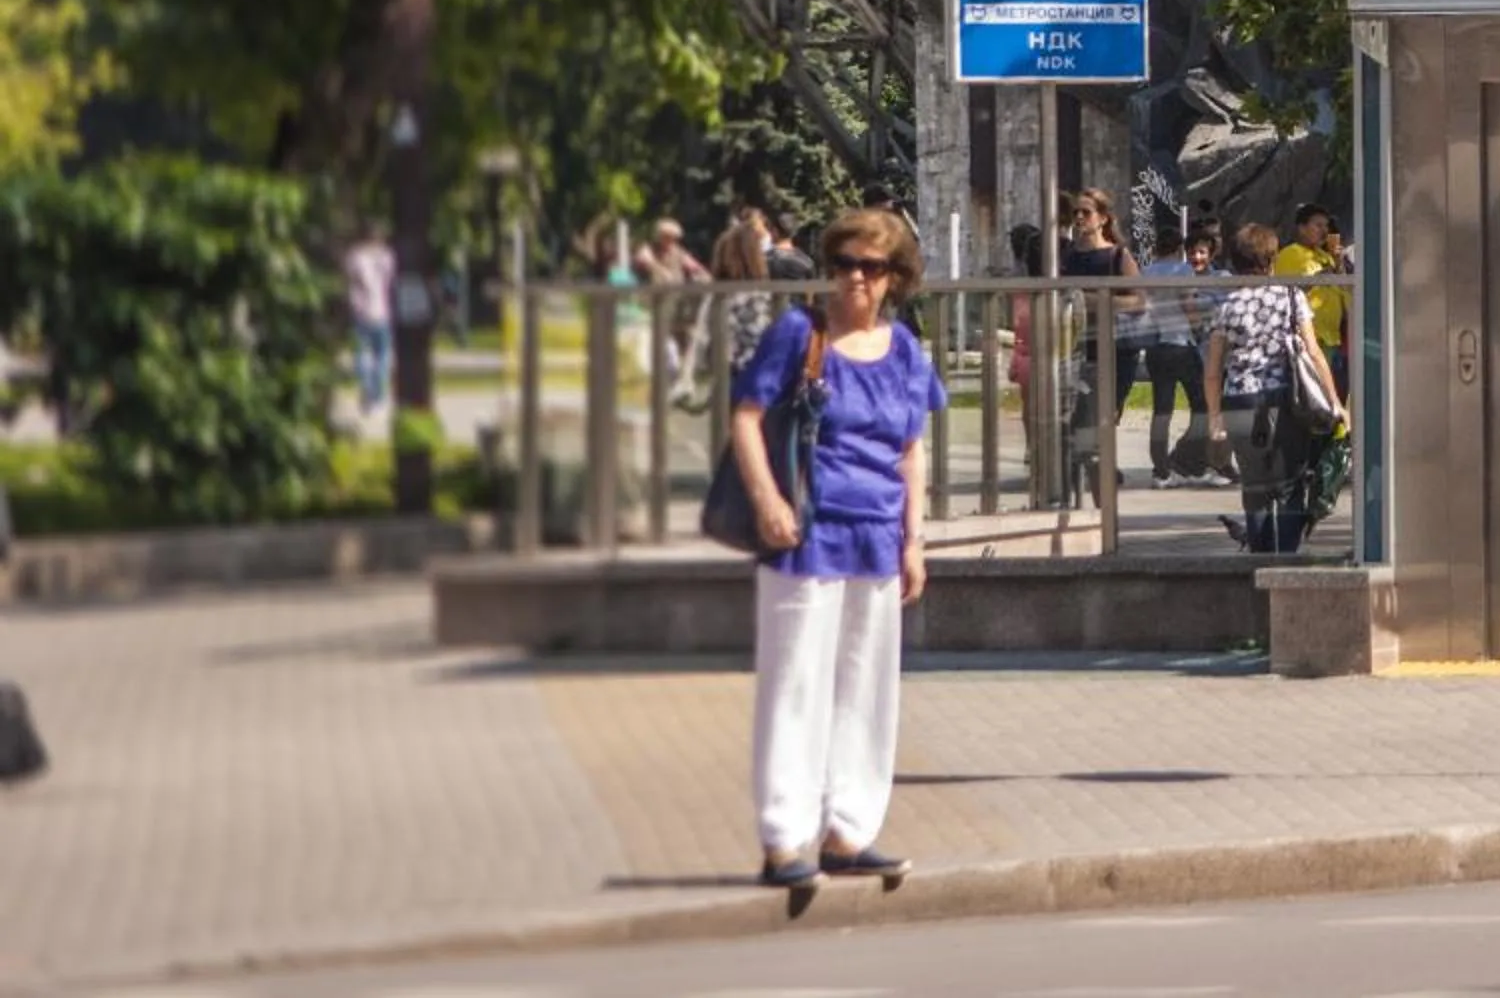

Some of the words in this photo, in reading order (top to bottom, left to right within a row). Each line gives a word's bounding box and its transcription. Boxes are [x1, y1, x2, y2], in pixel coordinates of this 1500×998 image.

[995, 6, 1115, 20] МЕТРОСТАНЦИЯ
[1028, 31, 1083, 50] НДК
[1036, 56, 1076, 69] NDK
